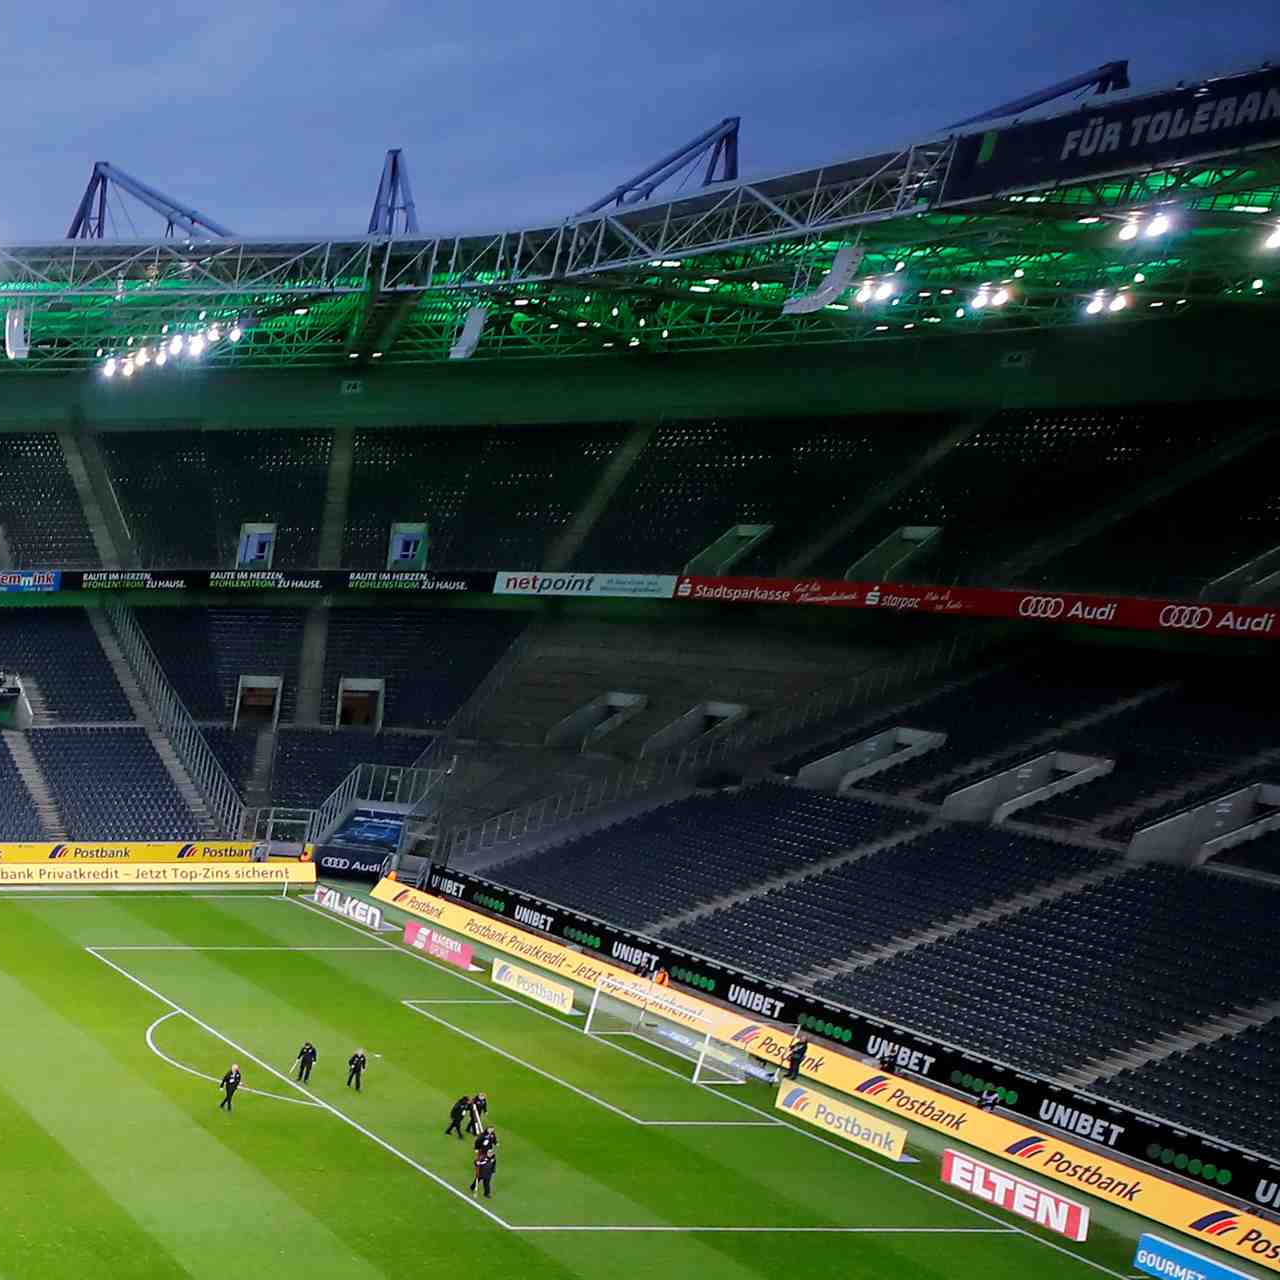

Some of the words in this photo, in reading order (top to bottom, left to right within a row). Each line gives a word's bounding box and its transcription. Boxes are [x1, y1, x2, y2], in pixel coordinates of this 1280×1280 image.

[1060, 118, 1121, 160] FÜR
[505, 575, 595, 594] netpoint
[694, 584, 791, 602] Stadtsparkasse
[1066, 600, 1119, 621] Audi
[1215, 610, 1276, 632] Audi
[73, 846, 130, 860] Postbank
[351, 860, 381, 873] Audi
[38, 868, 120, 881] Privatkredit
[134, 868, 168, 881] Jetzt
[171, 867, 231, 883] Top-Zins
[314, 884, 382, 930] FALKEN
[514, 904, 555, 932] UNIBET
[463, 917, 507, 946] Postbank
[508, 934, 568, 969] Privatkredit
[611, 940, 660, 972] UNIBET
[515, 973, 569, 1009] Postbank
[728, 983, 785, 1019] UNIBET
[814, 1102, 895, 1153] Postbank
[887, 1088, 969, 1132] Postbank
[1039, 1098, 1125, 1146] UNIBET
[950, 1152, 1070, 1234] ELTEN
[1043, 1151, 1143, 1202] Postbank
